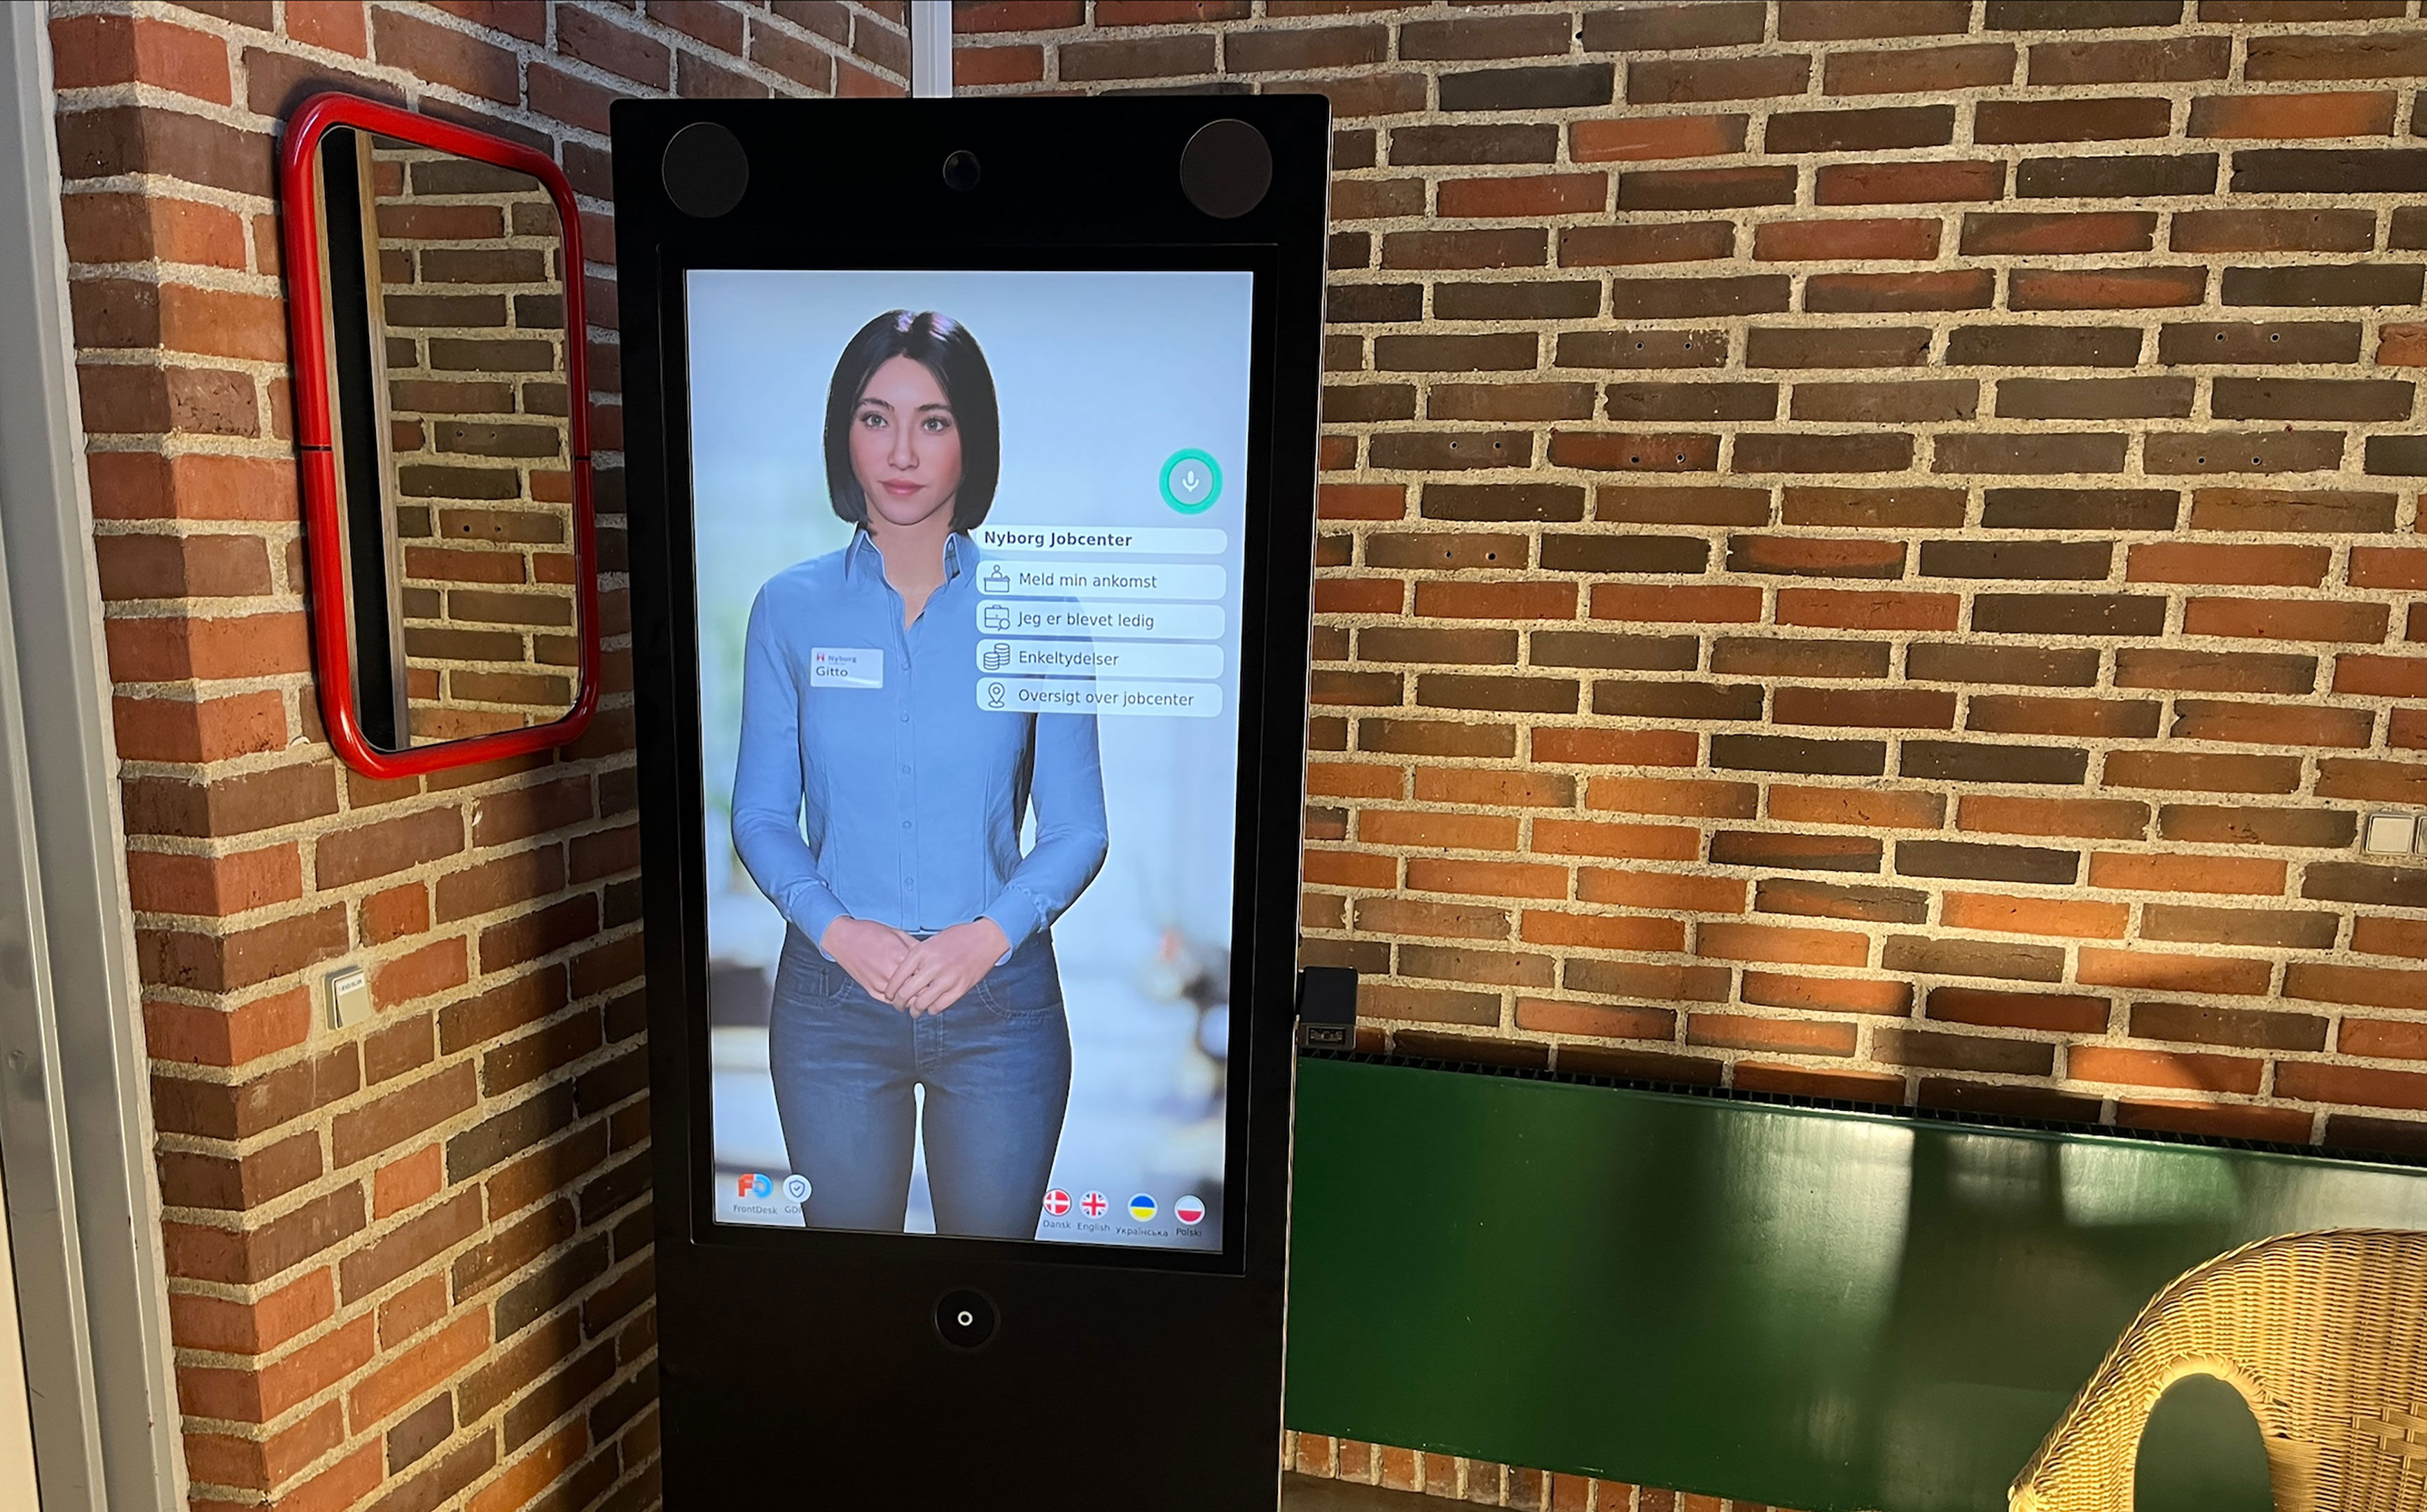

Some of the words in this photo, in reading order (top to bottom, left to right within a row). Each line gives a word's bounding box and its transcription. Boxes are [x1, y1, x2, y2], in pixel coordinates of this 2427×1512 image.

[985, 531, 1045, 547] Nyborg
[1050, 532, 1133, 547] Jobcenter
[1020, 573, 1055, 586] Meld
[1059, 573, 1087, 587] min
[1093, 574, 1157, 589] ankomst
[1017, 612, 1042, 627] Jeg
[1046, 614, 1062, 625] er
[1066, 612, 1113, 626] blevet
[1118, 613, 1155, 630] ledig
[1019, 651, 1119, 667] Enkeltydelser
[816, 666, 848, 677] Gitto
[1018, 689, 1081, 705] Oversigt
[1087, 692, 1119, 704] over
[1122, 691, 1195, 707] jobcenter
[733, 1205, 778, 1214] FrontDesk
[1043, 1219, 1071, 1229] Dansk
[1077, 1222, 1111, 1233] English
[1176, 1228, 1202, 1238] Polski
